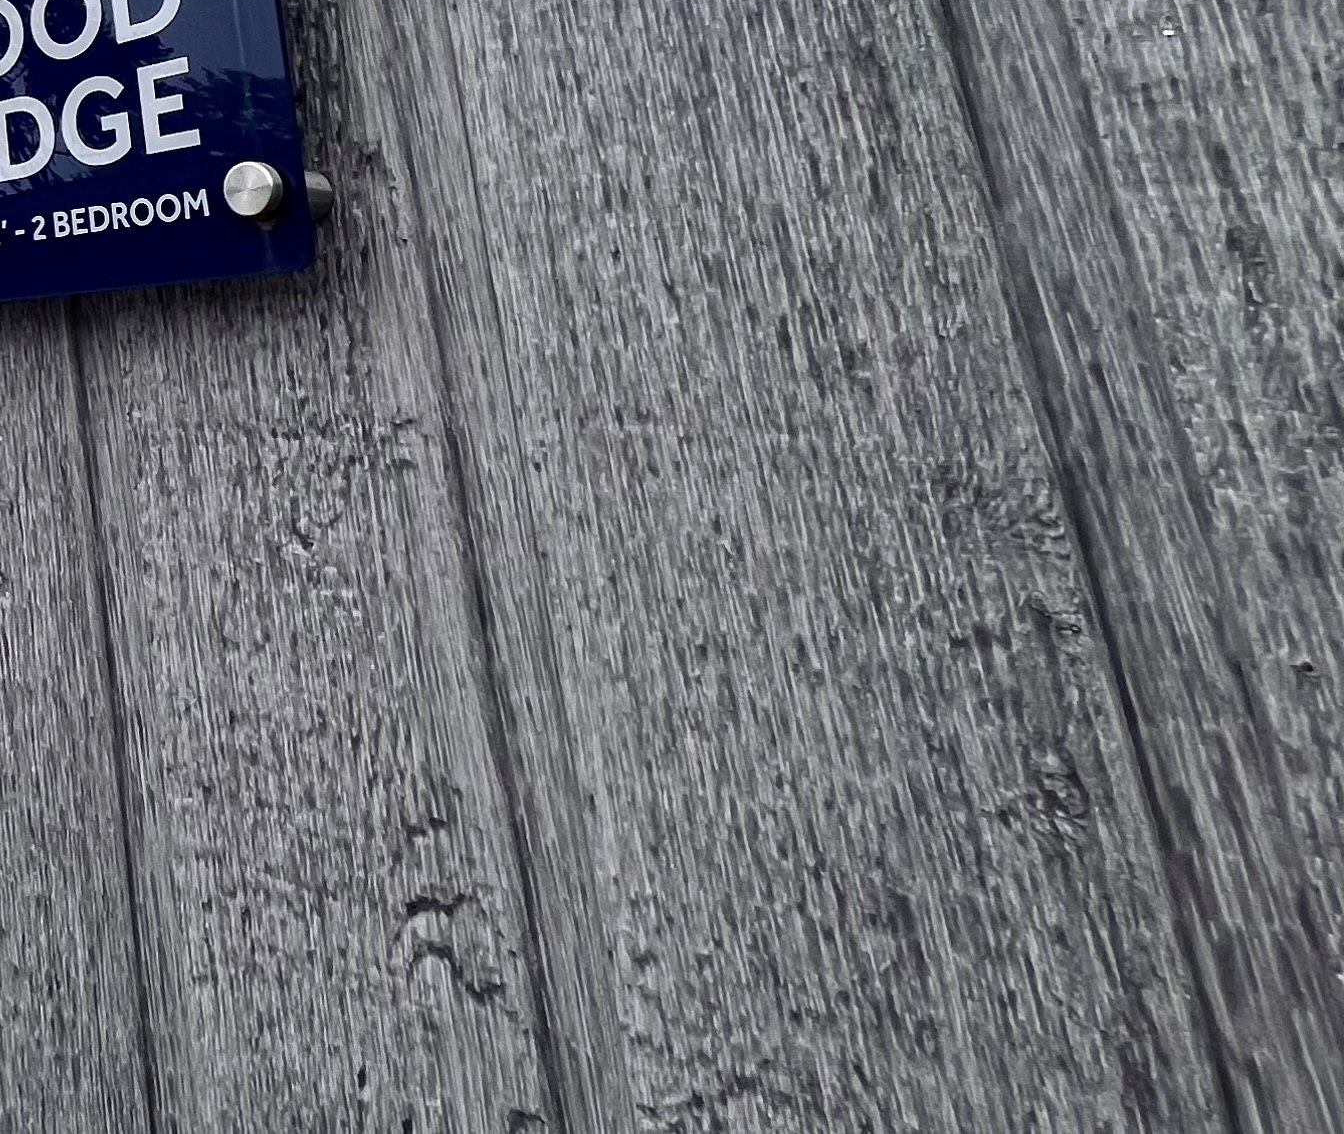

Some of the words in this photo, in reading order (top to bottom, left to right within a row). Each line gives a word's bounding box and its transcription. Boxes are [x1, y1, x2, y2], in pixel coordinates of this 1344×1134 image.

[13, 228, 26, 237] -
[30, 215, 48, 241] 2
[52, 188, 210, 239] BEDROOM
